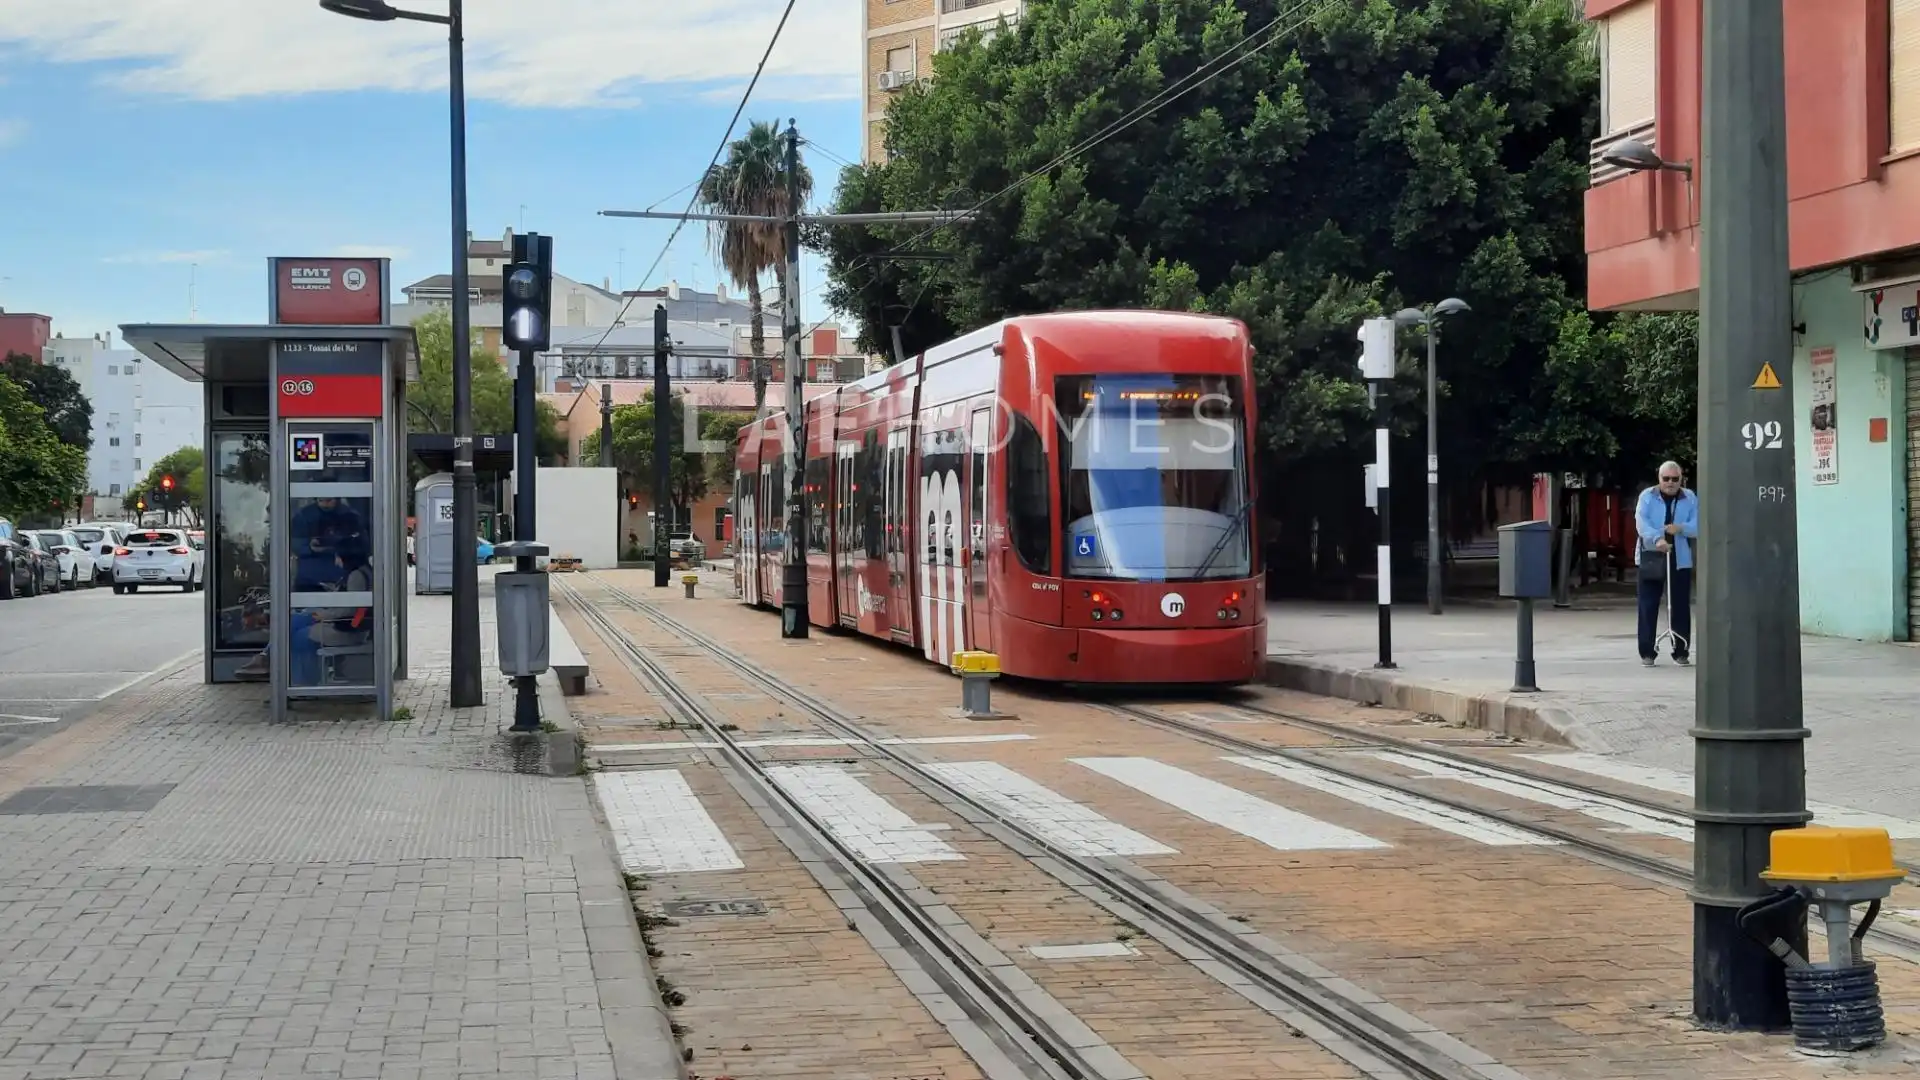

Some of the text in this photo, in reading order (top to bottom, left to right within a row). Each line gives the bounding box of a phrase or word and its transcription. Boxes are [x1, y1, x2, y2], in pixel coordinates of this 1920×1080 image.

[291, 267, 331, 277] EMT
[283, 344, 302, 352] 1133
[332, 343, 344, 352] del
[1741, 421, 1783, 450] 92
